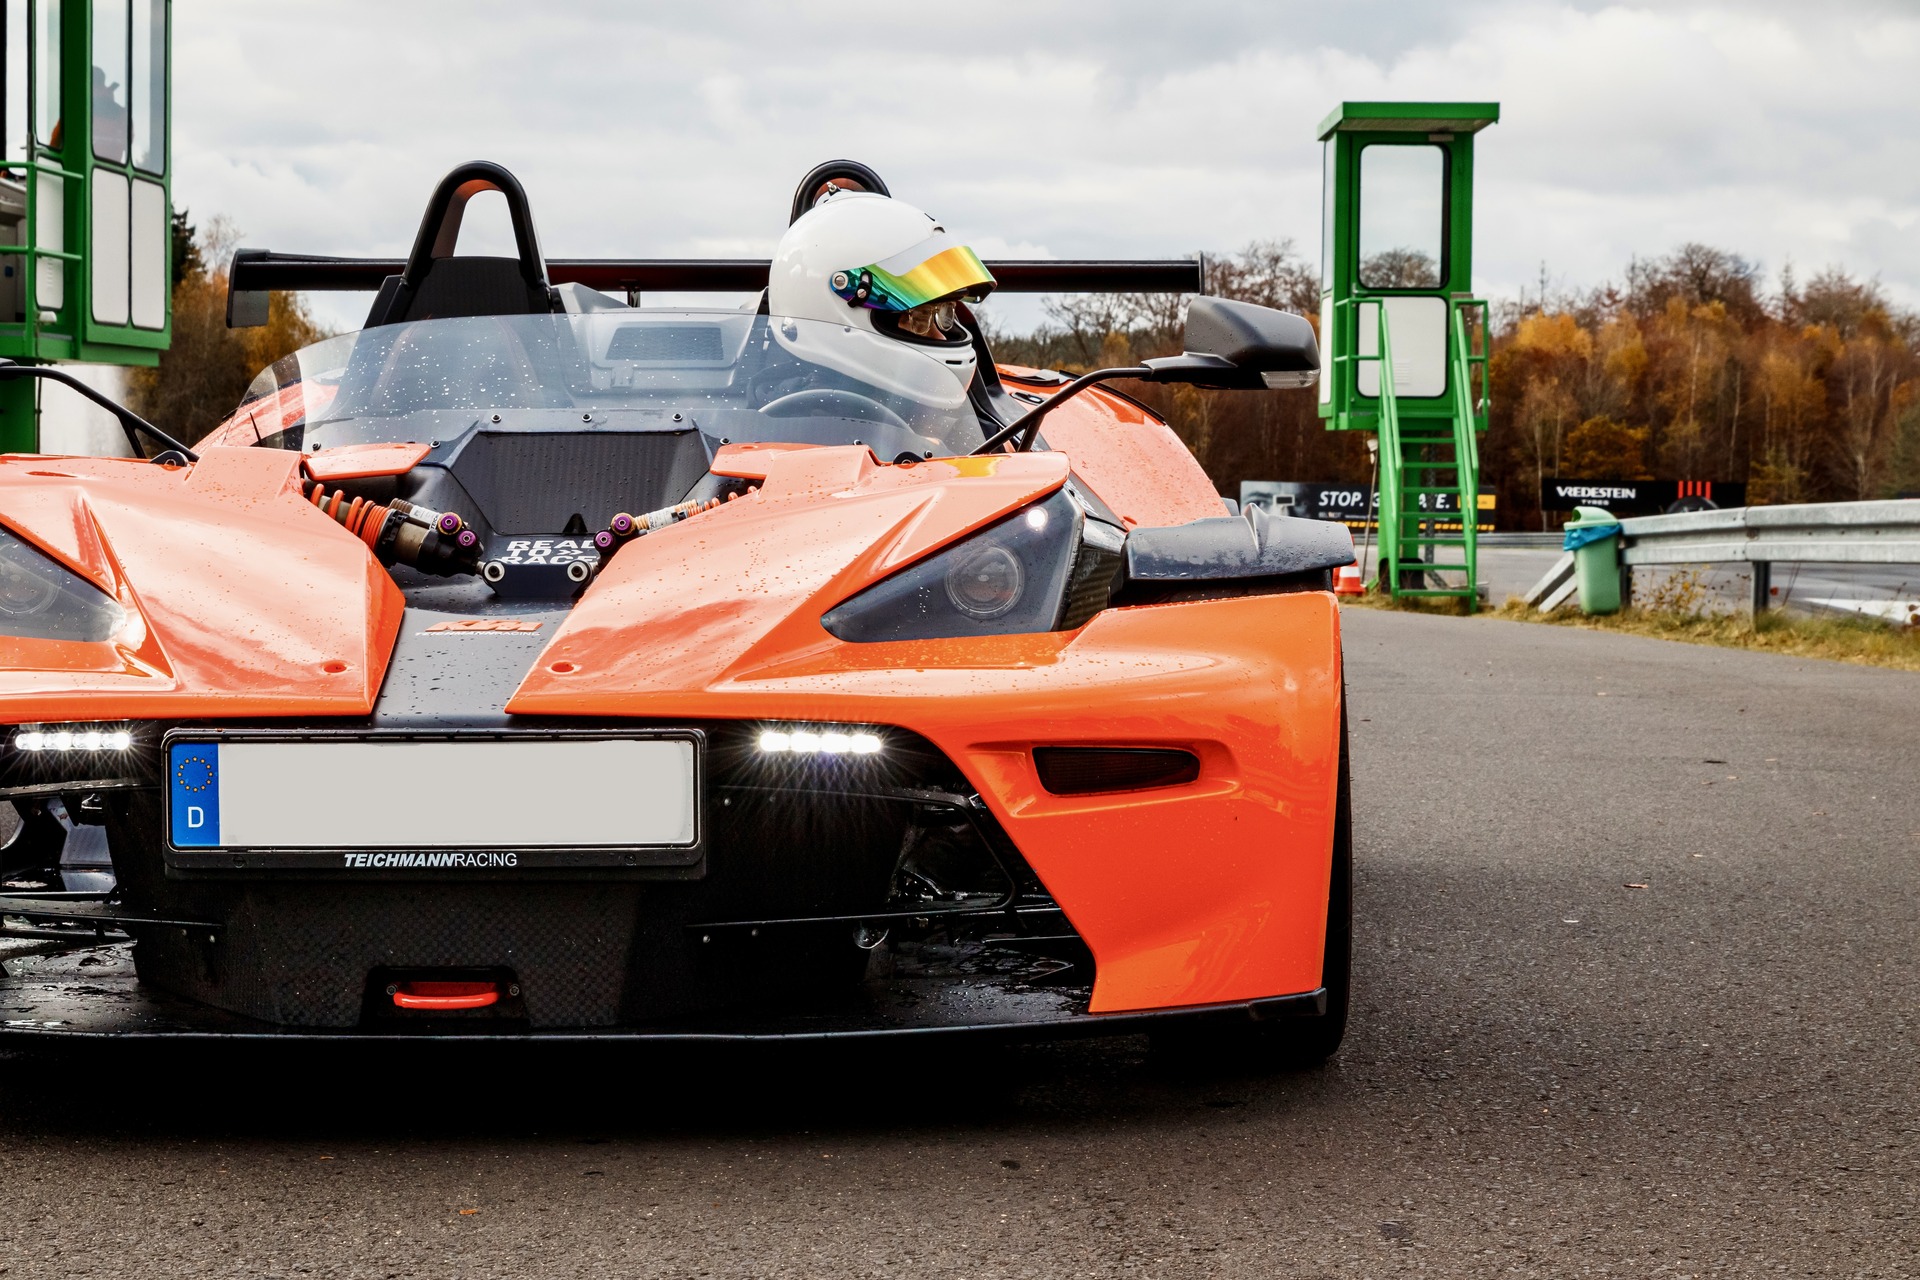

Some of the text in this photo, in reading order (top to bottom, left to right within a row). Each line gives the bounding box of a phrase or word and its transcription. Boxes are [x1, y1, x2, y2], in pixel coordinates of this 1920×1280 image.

[1318, 490, 1364, 507] STOP.
[1556, 486, 1636, 499] VREDESTEIN
[510, 548, 552, 557] TO
[188, 806, 204, 828] D
